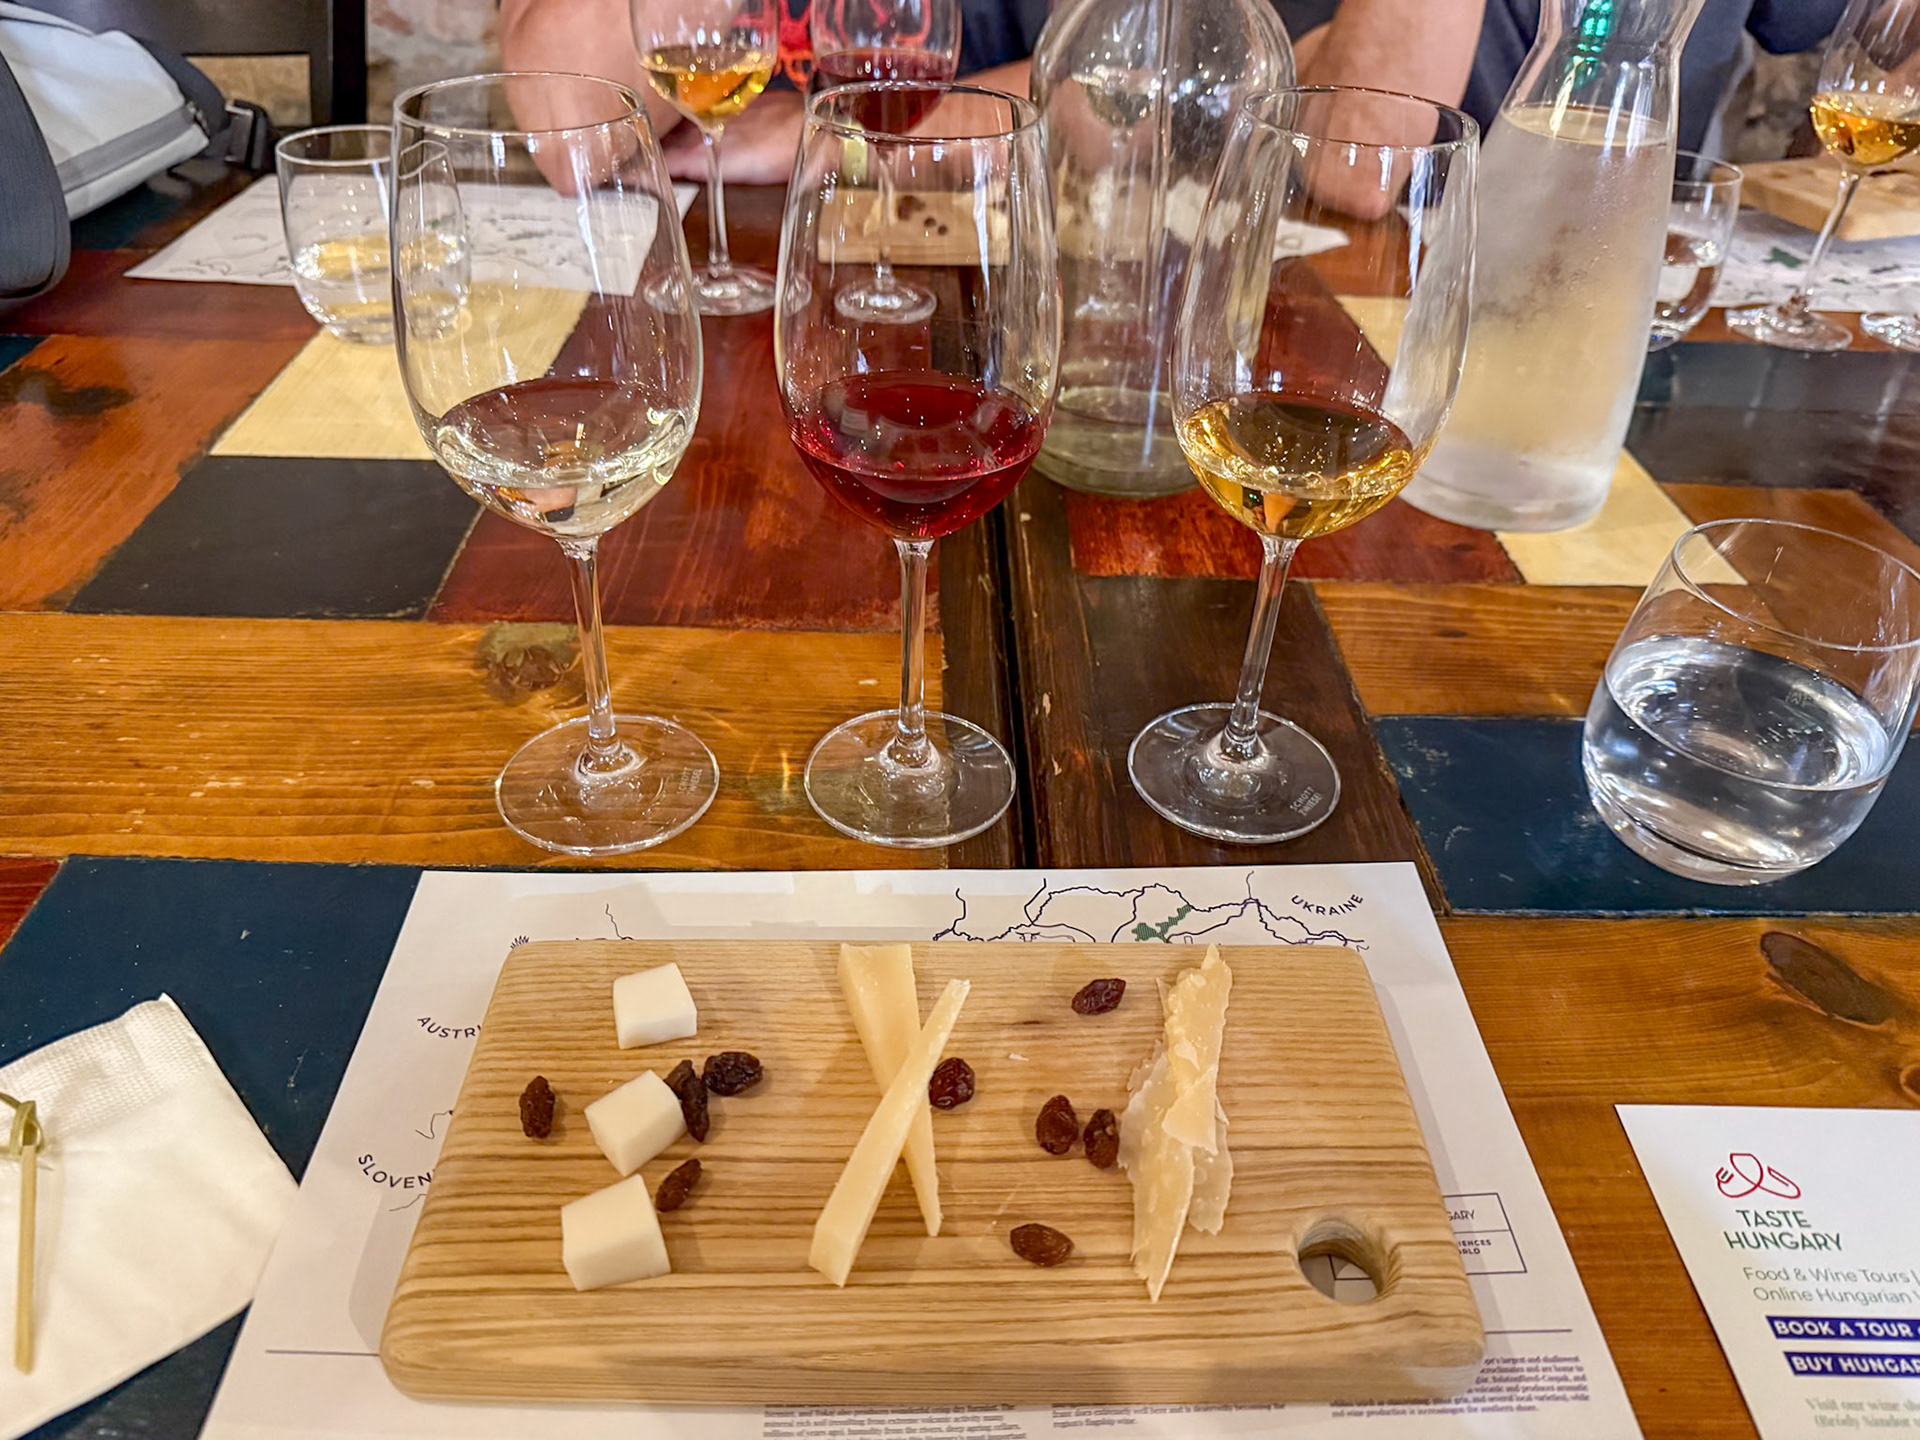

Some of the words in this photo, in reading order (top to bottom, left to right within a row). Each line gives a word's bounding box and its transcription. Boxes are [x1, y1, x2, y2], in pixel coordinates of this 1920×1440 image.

[1291, 894, 1363, 915] UKRAINE
[358, 1154, 434, 1188] SLOVEN
[1735, 1210, 1811, 1228] TASTE
[1723, 1231, 1842, 1251] HUNGARY
[1743, 1267, 1790, 1281] Food
[1795, 1268, 1807, 1281] &
[1808, 1268, 1857, 1282] Wine
[1859, 1268, 1910, 1283] Tours
[1753, 1287, 1813, 1301] Online
[1816, 1288, 1912, 1306] Hungarian
[1774, 1321, 1836, 1336] BOOK
[1839, 1321, 1855, 1336] A
[1855, 1322, 1914, 1337] TOUR
[1791, 1356, 1834, 1372] BUY
[1838, 1357, 1920, 1374] HUNGAR
